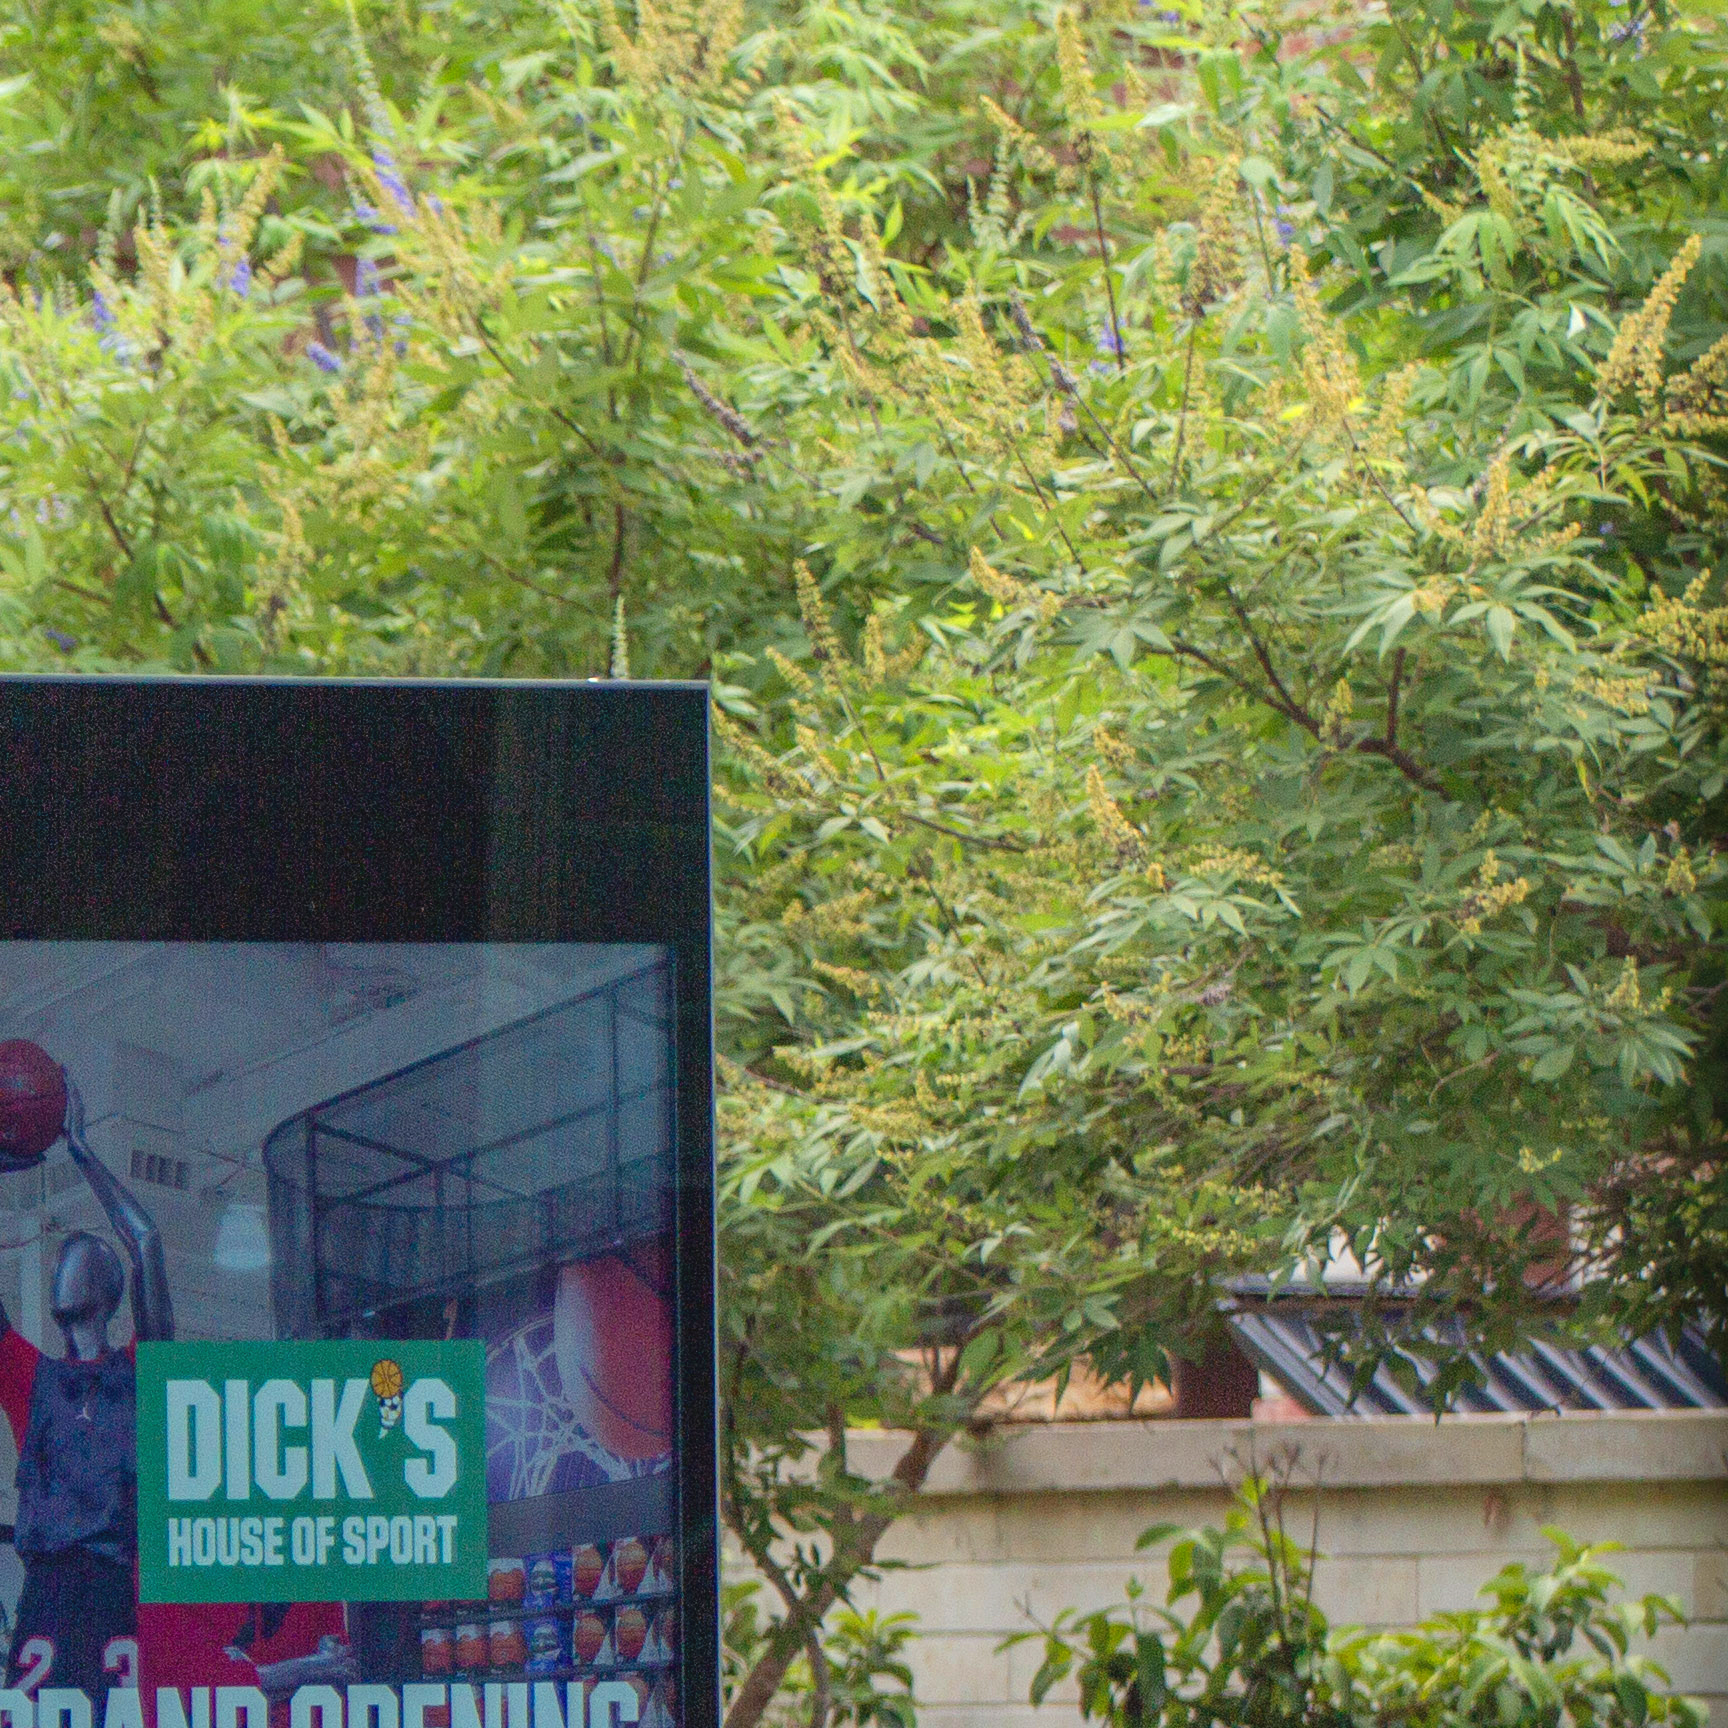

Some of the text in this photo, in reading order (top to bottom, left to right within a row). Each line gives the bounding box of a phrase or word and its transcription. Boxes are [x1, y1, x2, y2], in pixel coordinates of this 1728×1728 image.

[167, 1360, 457, 1500] DICK'S
[168, 1515, 458, 1566] HOUSE OF SPORT
